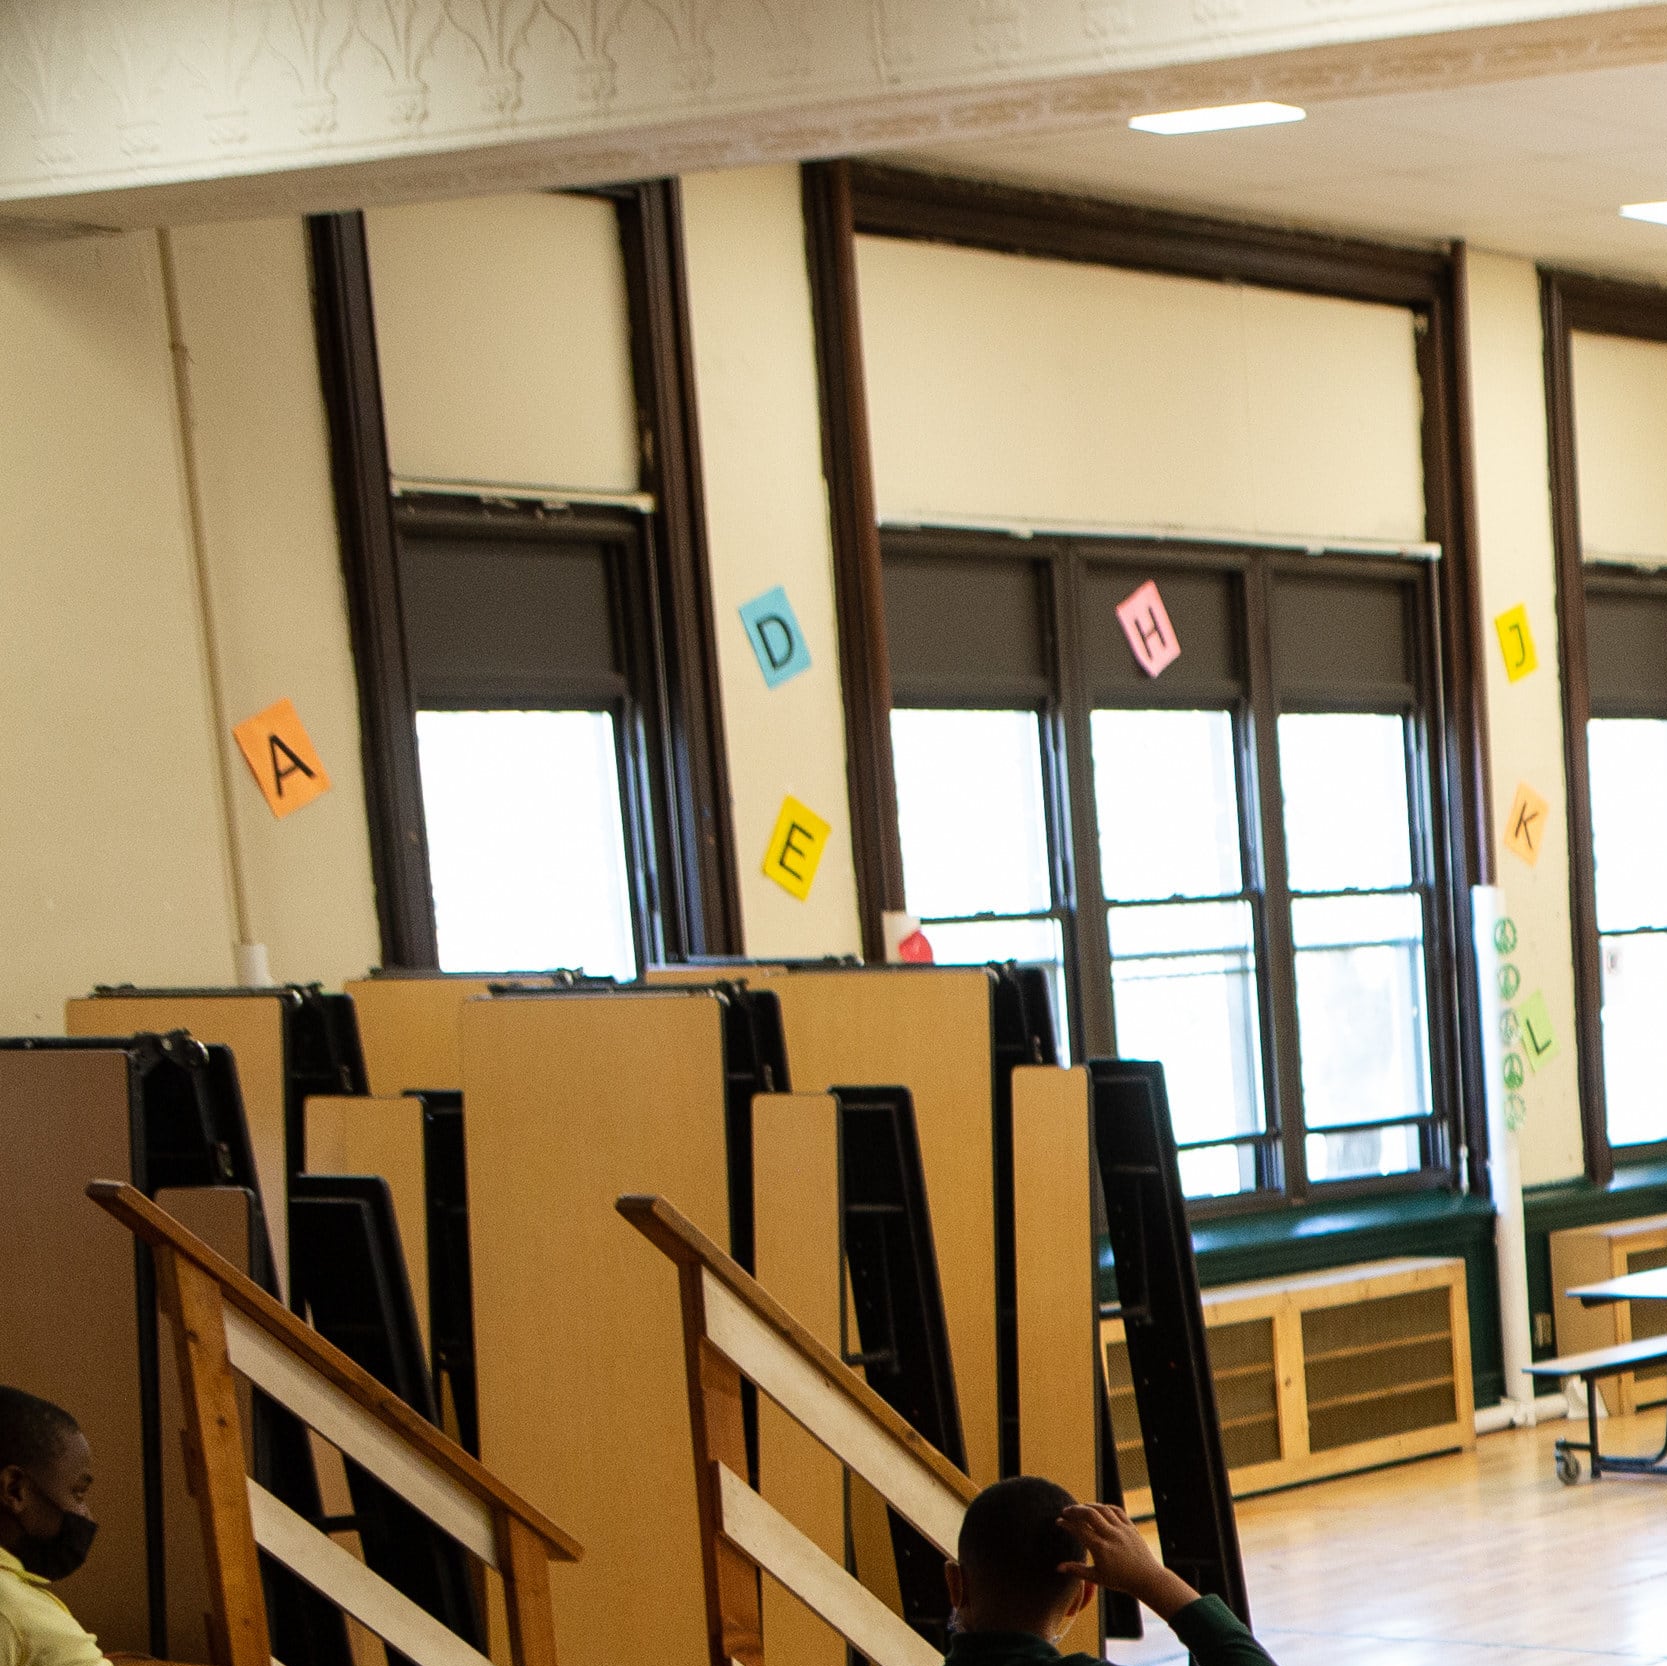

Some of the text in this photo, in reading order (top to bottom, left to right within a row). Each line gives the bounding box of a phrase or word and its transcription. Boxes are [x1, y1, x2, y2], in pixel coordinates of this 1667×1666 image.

[757, 616, 795, 670] D
[1135, 606, 1166, 660] H
[1509, 623, 1526, 668] J
[269, 734, 317, 797] A
[779, 823, 814, 881] E
[1514, 801, 1538, 851] K
[1526, 1018, 1552, 1056] L
